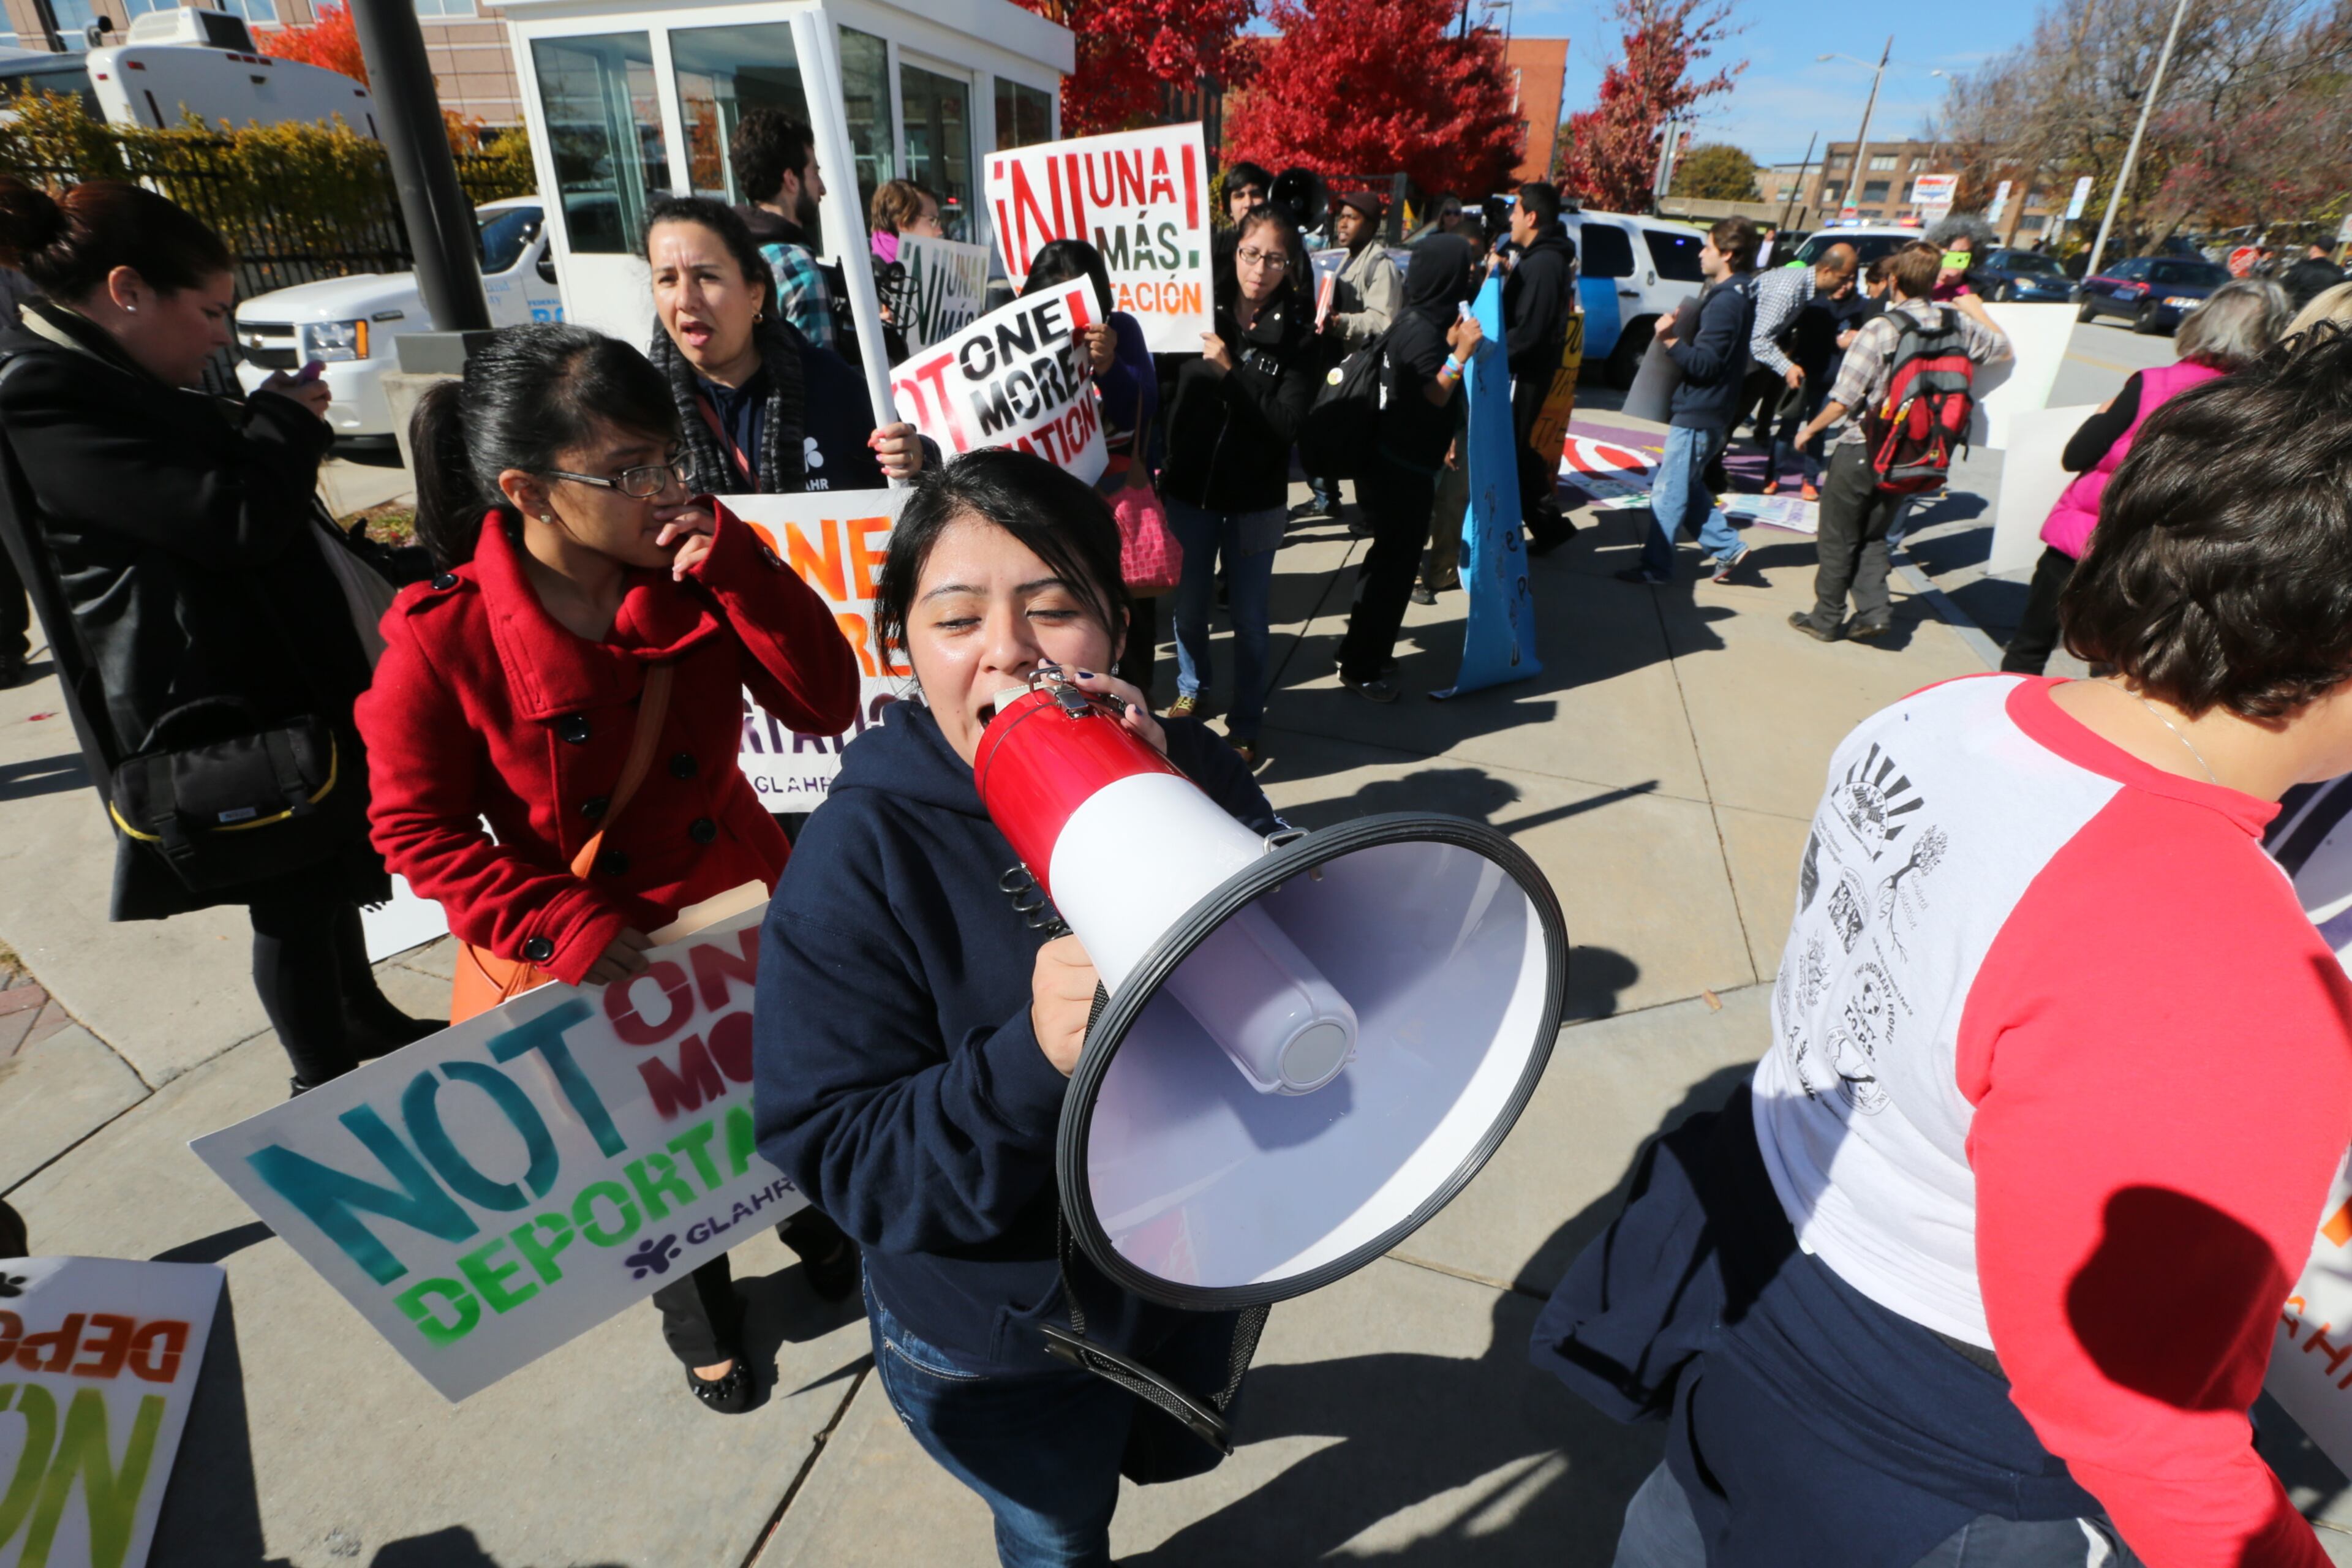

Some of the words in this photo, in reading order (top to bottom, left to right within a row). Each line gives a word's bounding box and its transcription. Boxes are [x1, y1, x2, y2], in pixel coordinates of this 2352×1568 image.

[1084, 146, 1177, 208] UNA
[1094, 210, 1181, 271] MÁS
[959, 297, 1069, 381] ONE
[970, 343, 1080, 437] MORE
[1852, 995, 1877, 1040] SOCIETY
[1865, 962, 1892, 999] ORDINARY
[245, 996, 627, 1286] NOT
[603, 924, 761, 1046] ON
[636, 1011, 755, 1123] MO
[391, 1098, 757, 1349] DEPORTA
